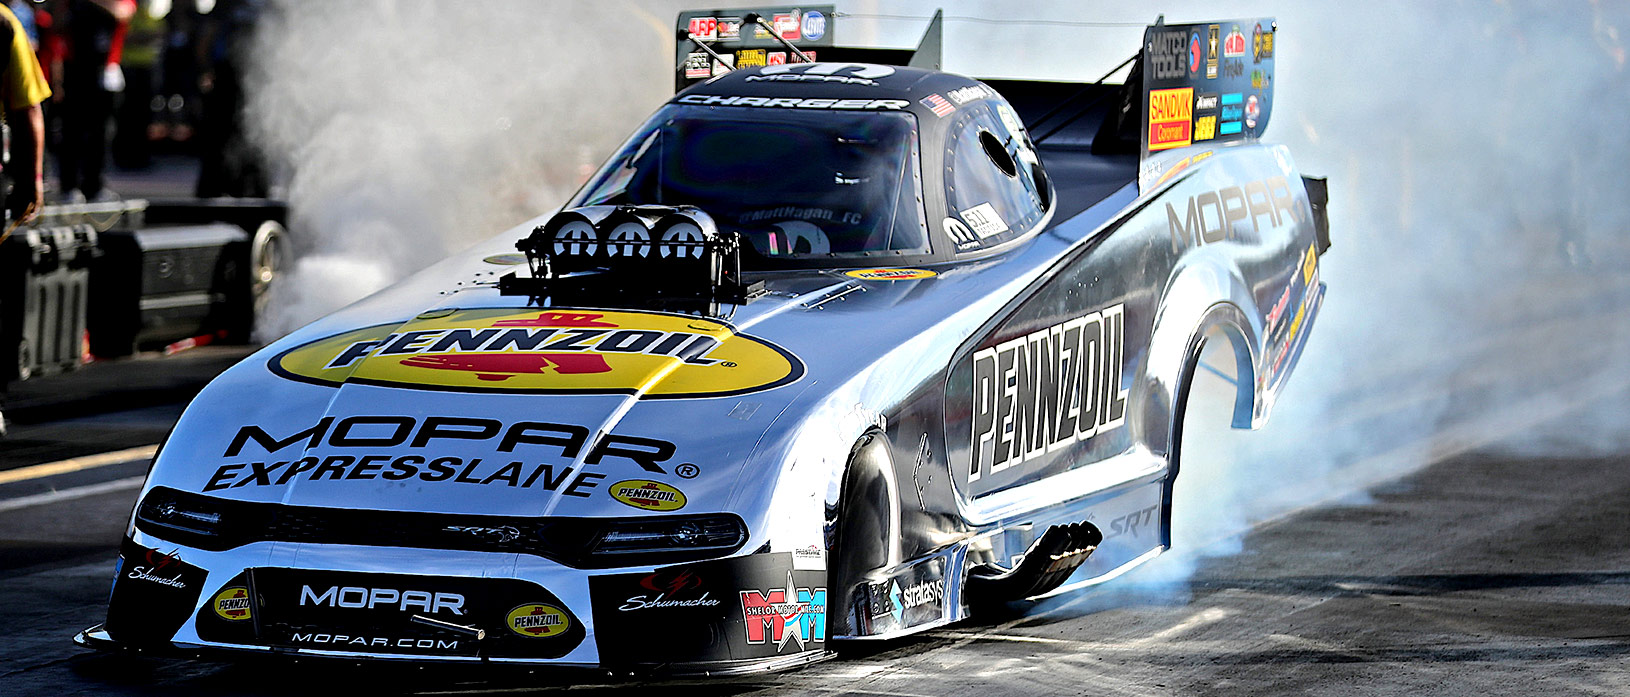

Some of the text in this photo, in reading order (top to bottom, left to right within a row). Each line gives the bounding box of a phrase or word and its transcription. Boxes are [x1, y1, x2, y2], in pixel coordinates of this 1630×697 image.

[1151, 31, 1187, 54] MATCO
[1151, 54, 1187, 79] TOOLS
[745, 74, 878, 87] MOPAR
[678, 94, 910, 109] CHARGER
[1151, 92, 1191, 120] SANDVIK
[1166, 175, 1298, 255] MOPAR
[324, 327, 722, 370] PENNZOIL
[968, 303, 1129, 483] PENNZOIL
[222, 415, 677, 475] MOPAR
[201, 455, 608, 498] EXPRESSLANE
[617, 486, 679, 503] PENNZOIL
[442, 525, 503, 536] SRT
[1107, 504, 1159, 539] SRT
[128, 566, 187, 589] Schumacher
[218, 597, 251, 611] PENNZO
[300, 584, 466, 615] MOPAR
[618, 592, 720, 612] Schumacher
[903, 579, 945, 609] stratasys
[514, 613, 564, 629] PENNZOIL
[746, 605, 776, 616] SHELOR
[292, 633, 458, 649] MOPAR.COM
